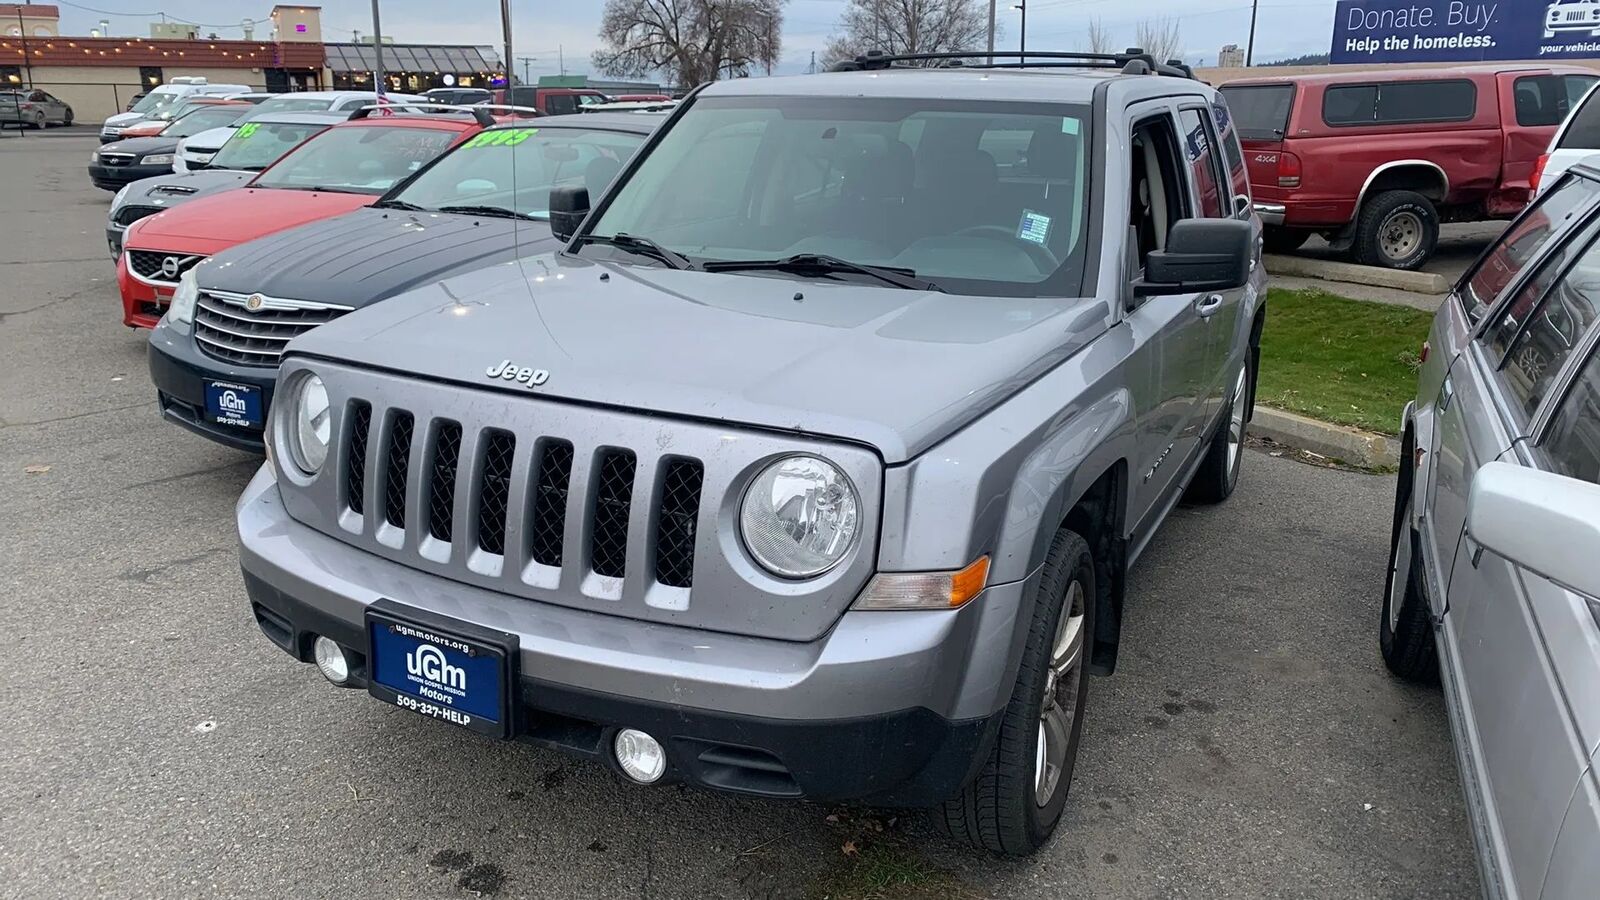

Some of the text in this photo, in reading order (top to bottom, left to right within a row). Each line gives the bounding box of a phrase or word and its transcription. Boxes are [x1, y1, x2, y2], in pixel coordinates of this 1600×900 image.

[1348, 1, 1498, 31] Donate. Buy.
[1345, 32, 1497, 54] Help the homeless.
[1540, 45, 1564, 55] your
[486, 360, 550, 389] Jeep
[395, 624, 469, 653] ugmmotors.org
[407, 674, 466, 697] UNION GOSPEL MISSION
[419, 685, 453, 704] Motors
[396, 694, 471, 726] 509-327-HELP
